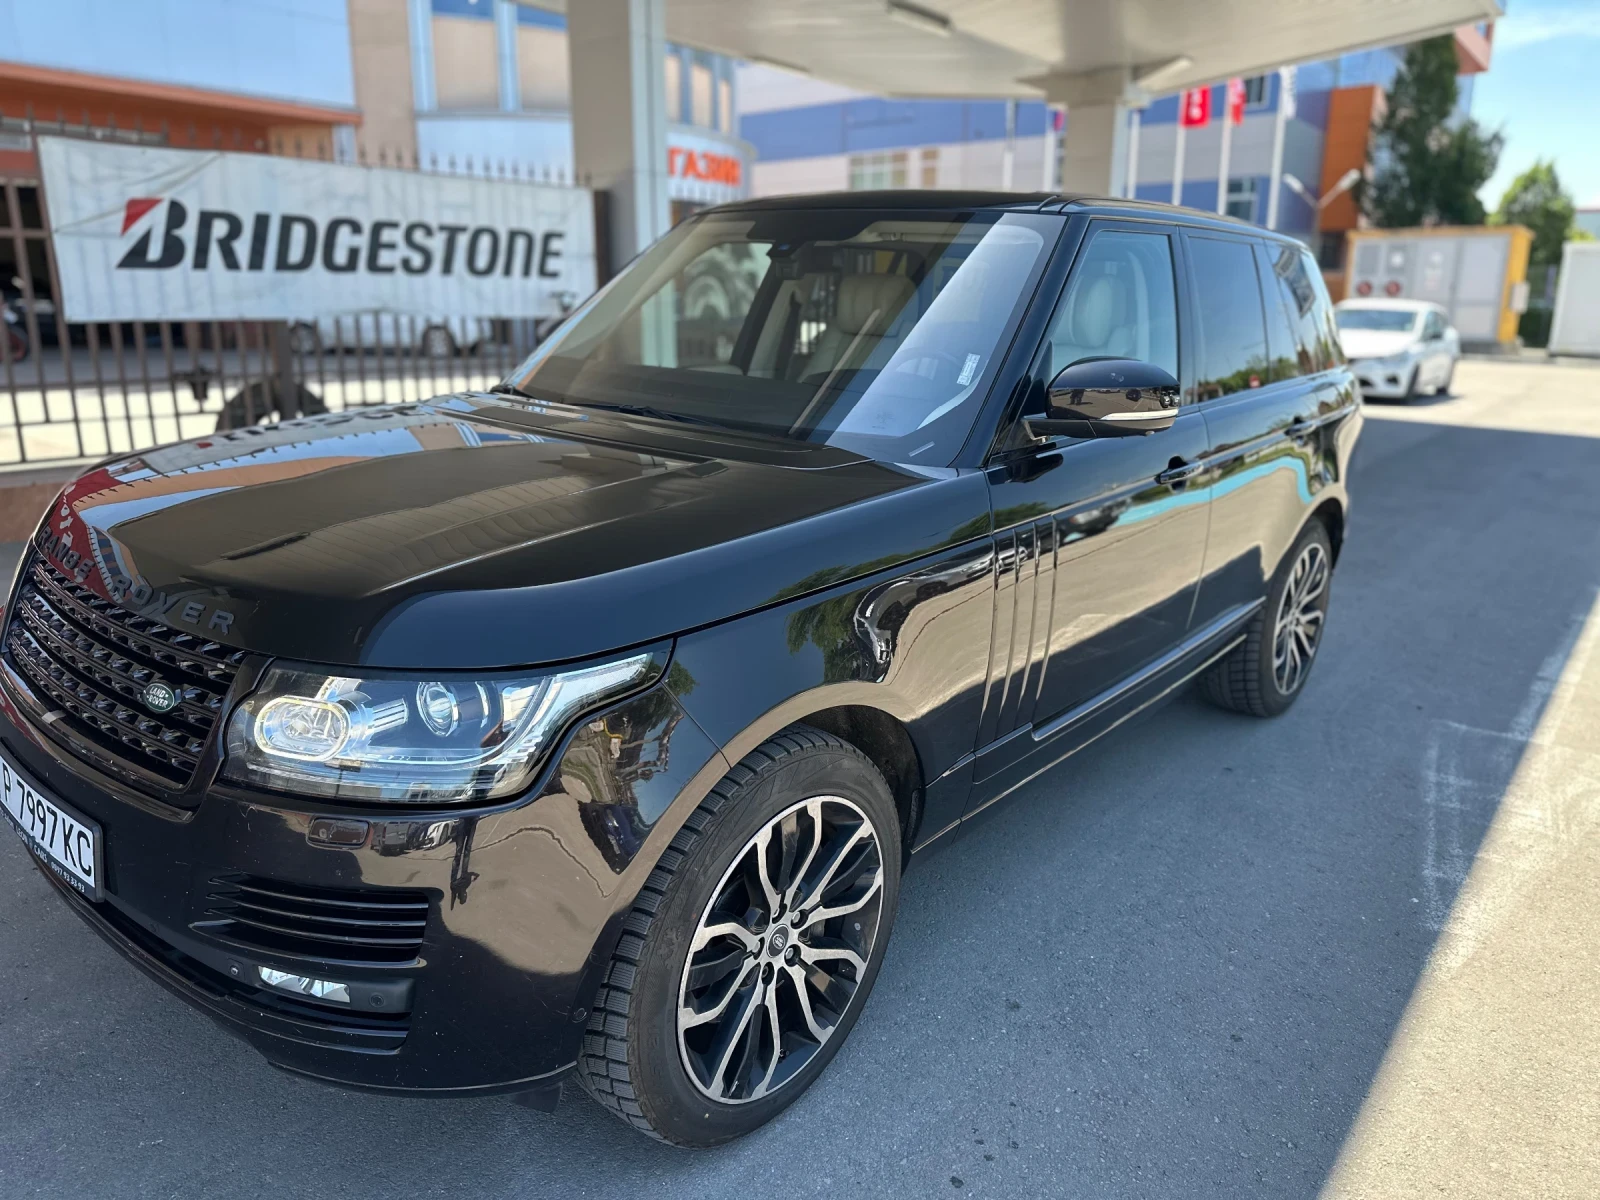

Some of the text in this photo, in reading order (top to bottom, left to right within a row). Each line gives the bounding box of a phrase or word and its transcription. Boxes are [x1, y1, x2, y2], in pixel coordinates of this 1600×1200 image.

[117, 197, 565, 278] BRIDGESTONE
[38, 526, 235, 635] RANGE ROVER
[148, 695, 168, 708] ROVER
[149, 686, 166, 698] LAND
[2, 762, 12, 802] P
[16, 782, 58, 849] 7997
[62, 817, 92, 878] KC
